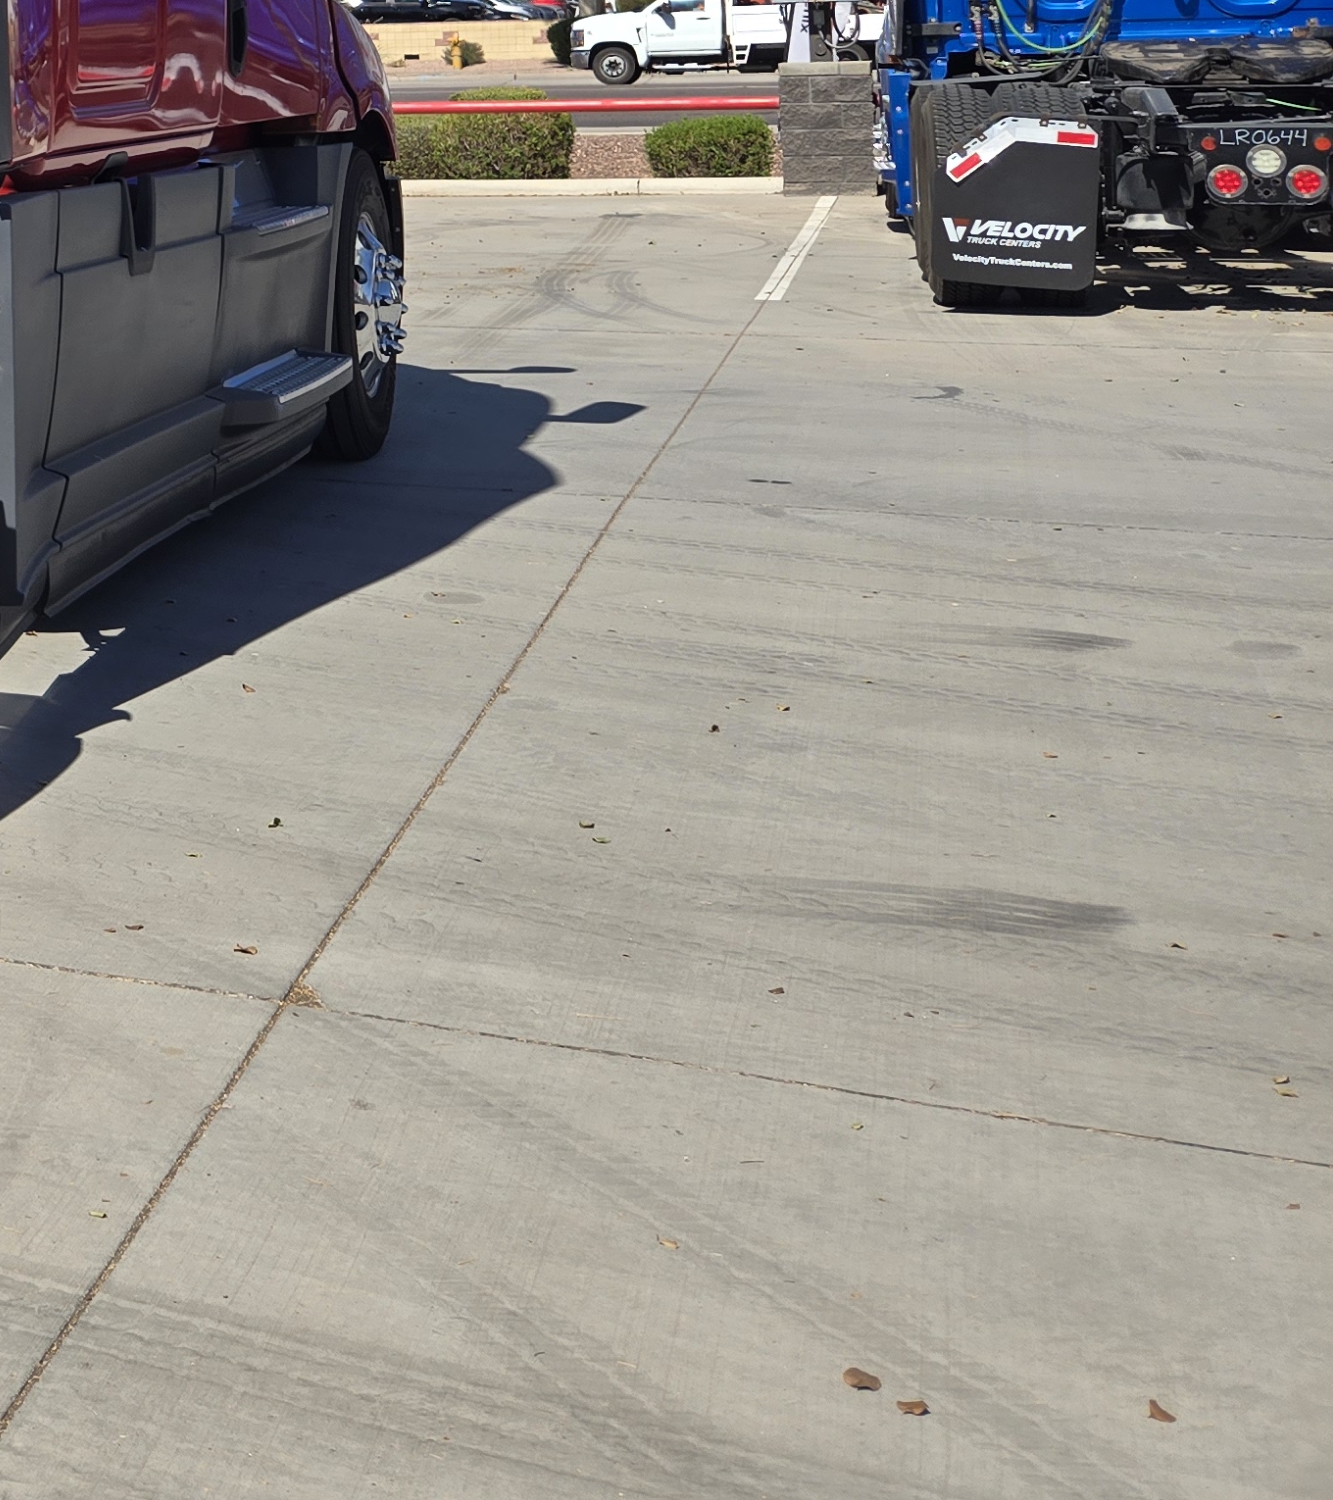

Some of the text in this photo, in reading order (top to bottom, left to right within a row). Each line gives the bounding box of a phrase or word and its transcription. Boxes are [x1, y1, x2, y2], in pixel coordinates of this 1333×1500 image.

[1219, 128, 1308, 147] LR0644
[969, 218, 1087, 242] VELOCITY
[966, 236, 1042, 249] TRUCK CENTERS
[952, 252, 1073, 270] VelocityTruckCenters.com
